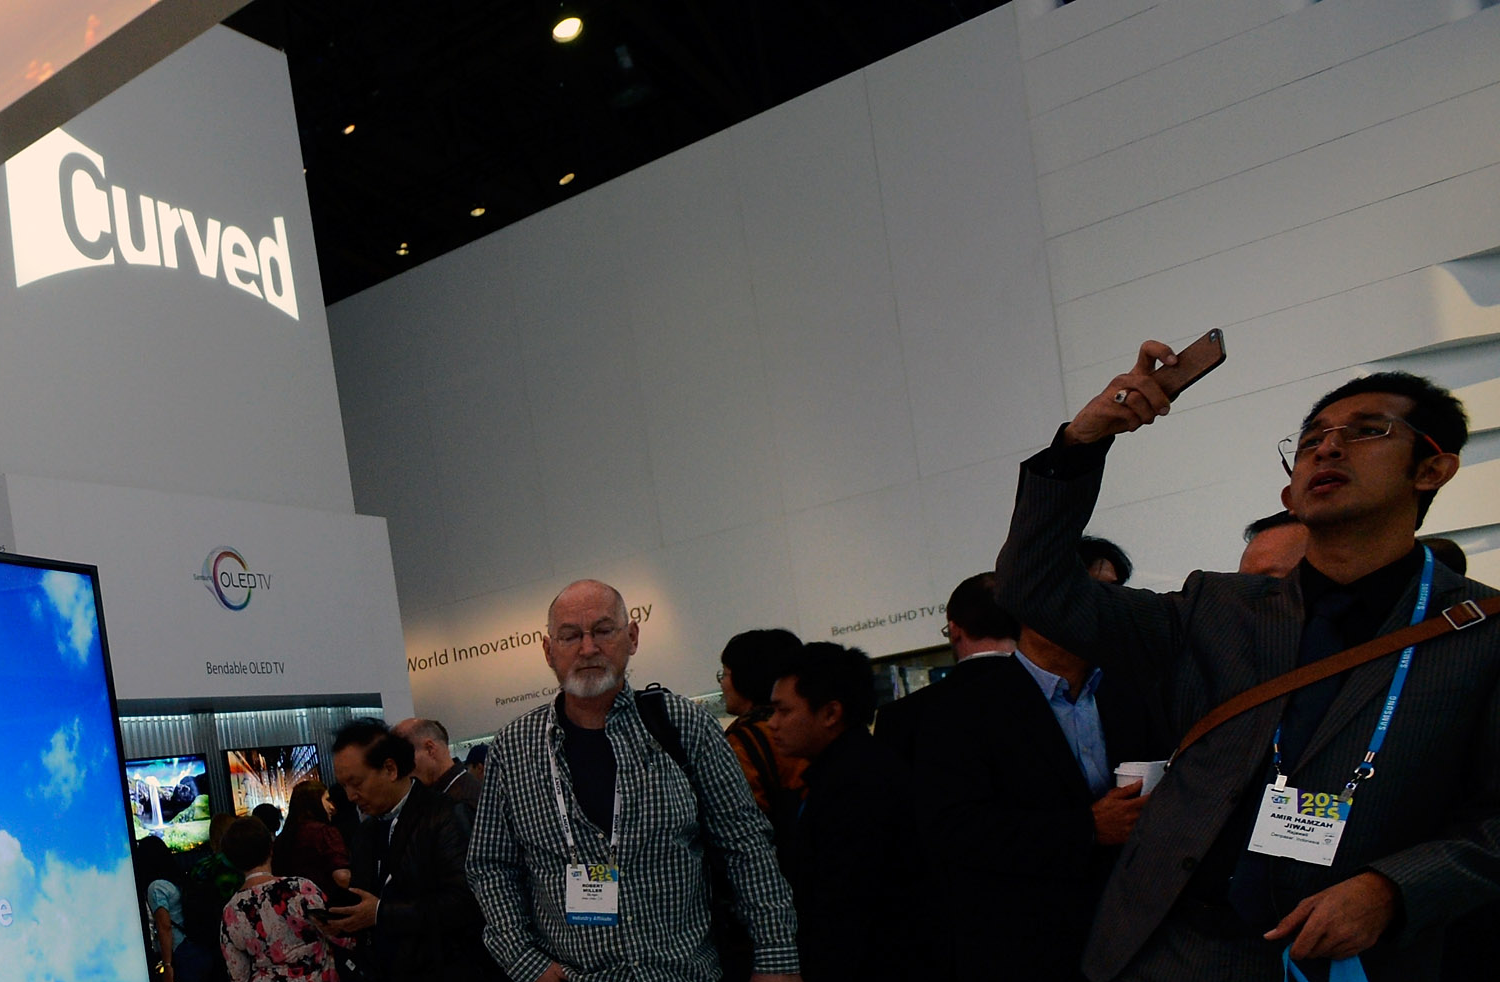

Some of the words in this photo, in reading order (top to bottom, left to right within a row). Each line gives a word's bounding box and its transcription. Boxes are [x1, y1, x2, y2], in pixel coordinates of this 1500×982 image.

[58, 151, 300, 321] Curved
[831, 617, 887, 637] Bendable
[888, 609, 918, 625] UHD
[919, 606, 935, 618] TV
[453, 630, 543, 662] Innovation
[206, 661, 248, 675] Bendable
[248, 661, 273, 675] OLED
[273, 661, 285, 674] TV
[495, 690, 540, 706] Panoramic
[1378, 695, 1398, 731] SAMSUNG
[1270, 813, 1292, 823] AMIR
[1294, 817, 1334, 829] HAMZAH
